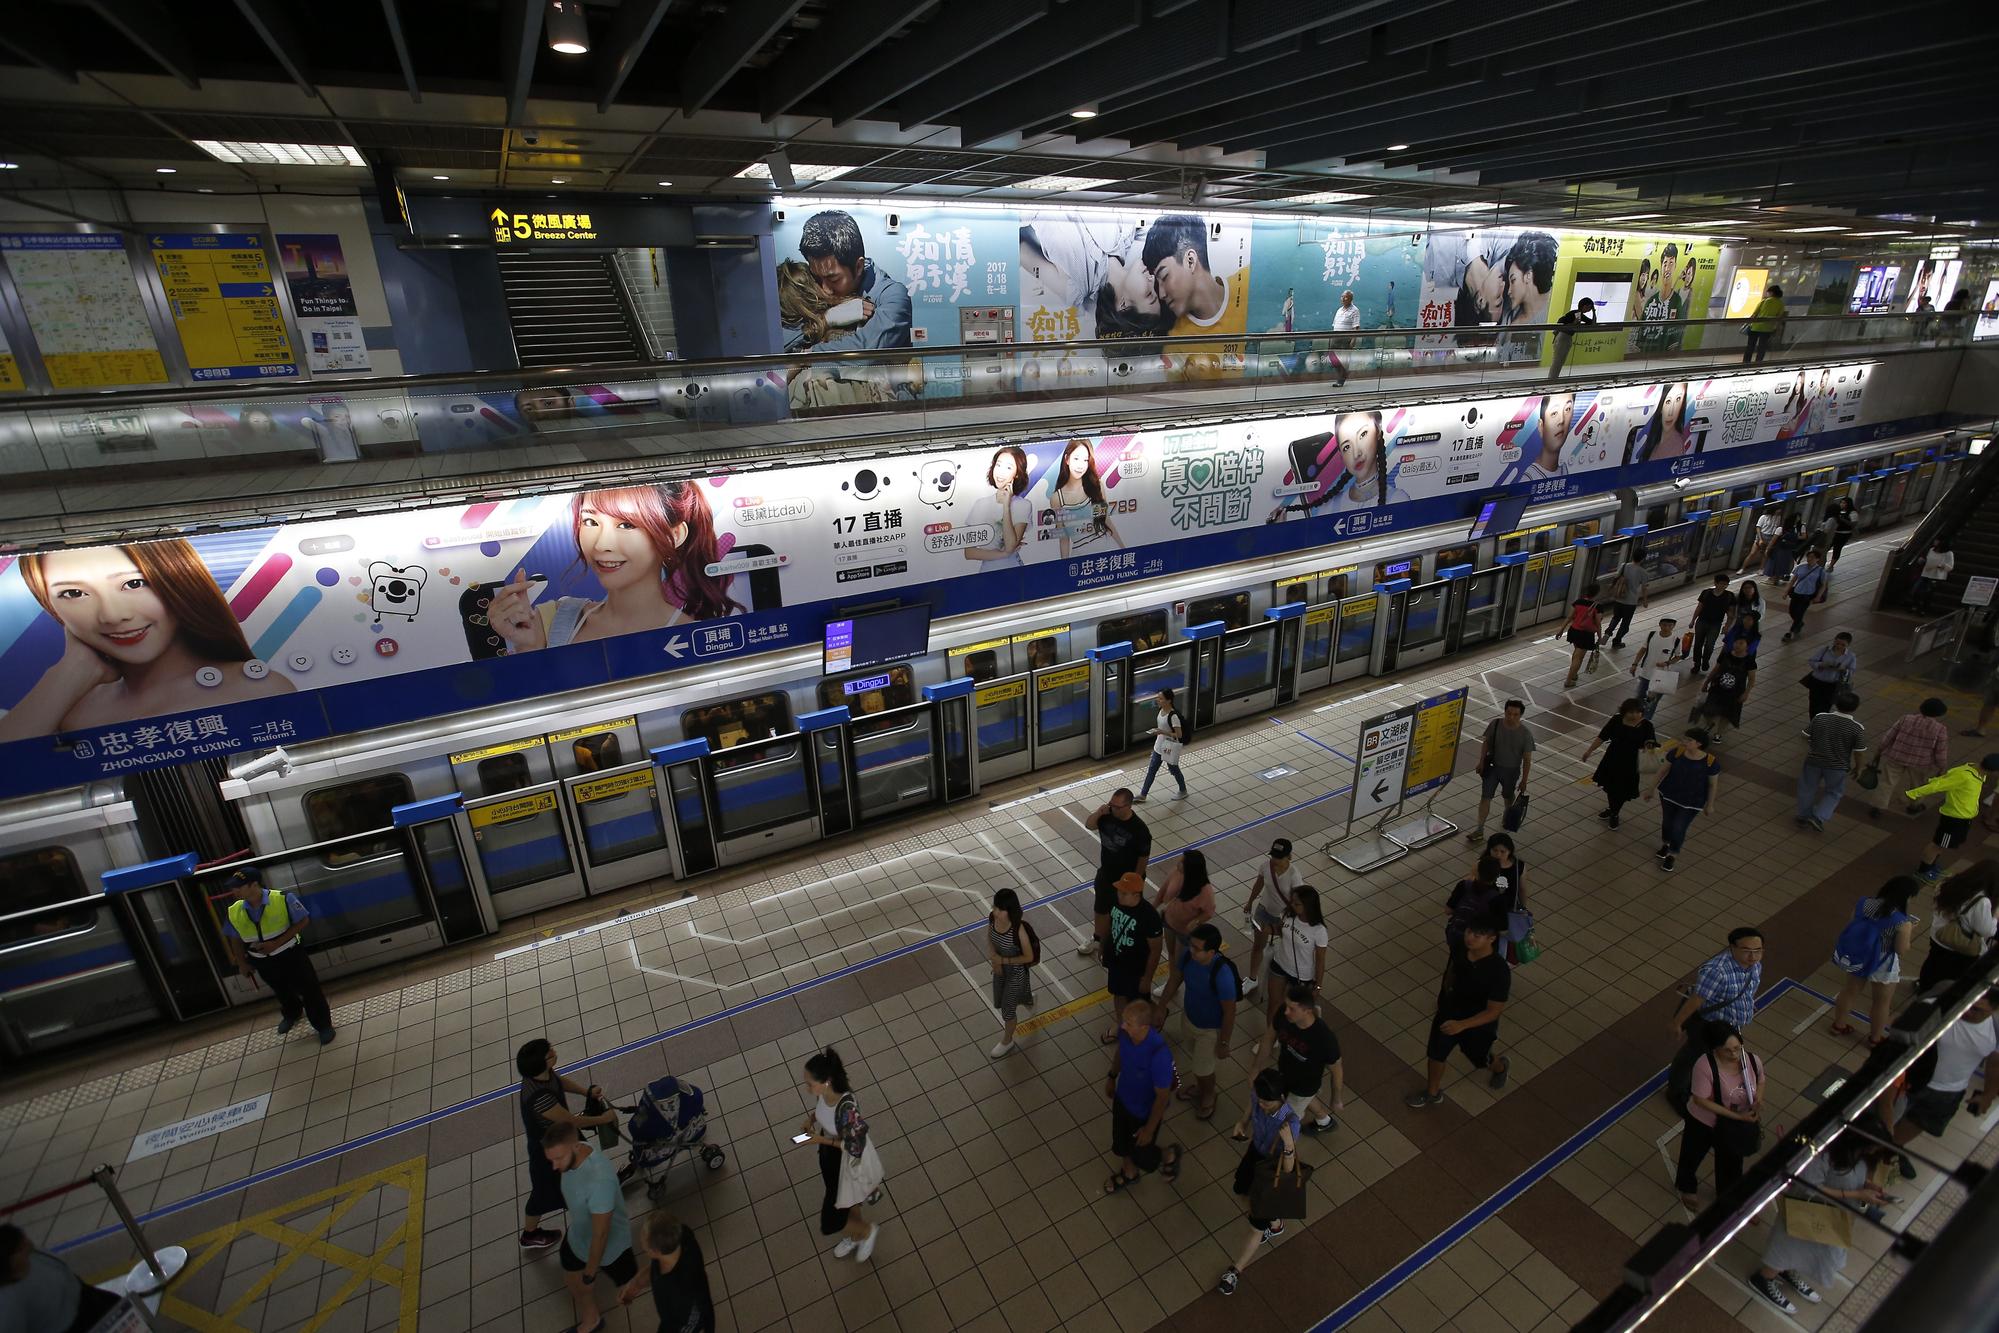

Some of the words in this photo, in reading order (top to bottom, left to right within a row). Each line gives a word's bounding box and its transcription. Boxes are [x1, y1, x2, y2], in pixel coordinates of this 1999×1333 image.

[513, 214, 532, 239] 5
[532, 214, 592, 229] 微風廣場
[534, 231, 566, 240] Breeze
[567, 231, 598, 239] Center
[896, 223, 977, 266] 痴情
[987, 262, 1007, 272] 2017
[906, 261, 972, 304] 男子漢
[986, 274, 1007, 284] 8/18
[986, 284, 1008, 295] 在一起
[314, 298, 338, 306] Things
[321, 305, 343, 313] Taipei
[1420, 299, 1452, 323] 痴情
[1026, 304, 1081, 336] 痴情
[1223, 343, 1238, 353] 2017
[1452, 439, 1464, 451] 17
[1464, 435, 1484, 451] 直播
[1170, 485, 1251, 530] 不間斷
[832, 516, 857, 535] 17
[862, 508, 903, 532] 直播
[1080, 552, 1136, 576] 忠孝復興
[1077, 574, 1115, 587] ZHONGXIAO
[1116, 569, 1139, 579] FUXING
[704, 627, 731, 644] 頂埔
[747, 623, 788, 639] 台北車站
[706, 641, 734, 652] Dingpu
[857, 678, 884, 689] Dingpu
[99, 714, 229, 756] 忠孝復興
[250, 719, 293, 737] 二月台
[1380, 720, 1409, 742] 文湖線
[1366, 735, 1378, 747] BR
[79, 749, 91, 757] 15
[101, 748, 186, 772] ZHONGXIAO
[192, 738, 242, 755] FUXING
[253, 732, 290, 744] Platform
[615, 911, 647, 924] Waiting
[648, 905, 667, 915] Line
[153, 1138, 176, 1150] Safe
[179, 1125, 216, 1140] Waiting
[220, 1116, 244, 1128] Zone
